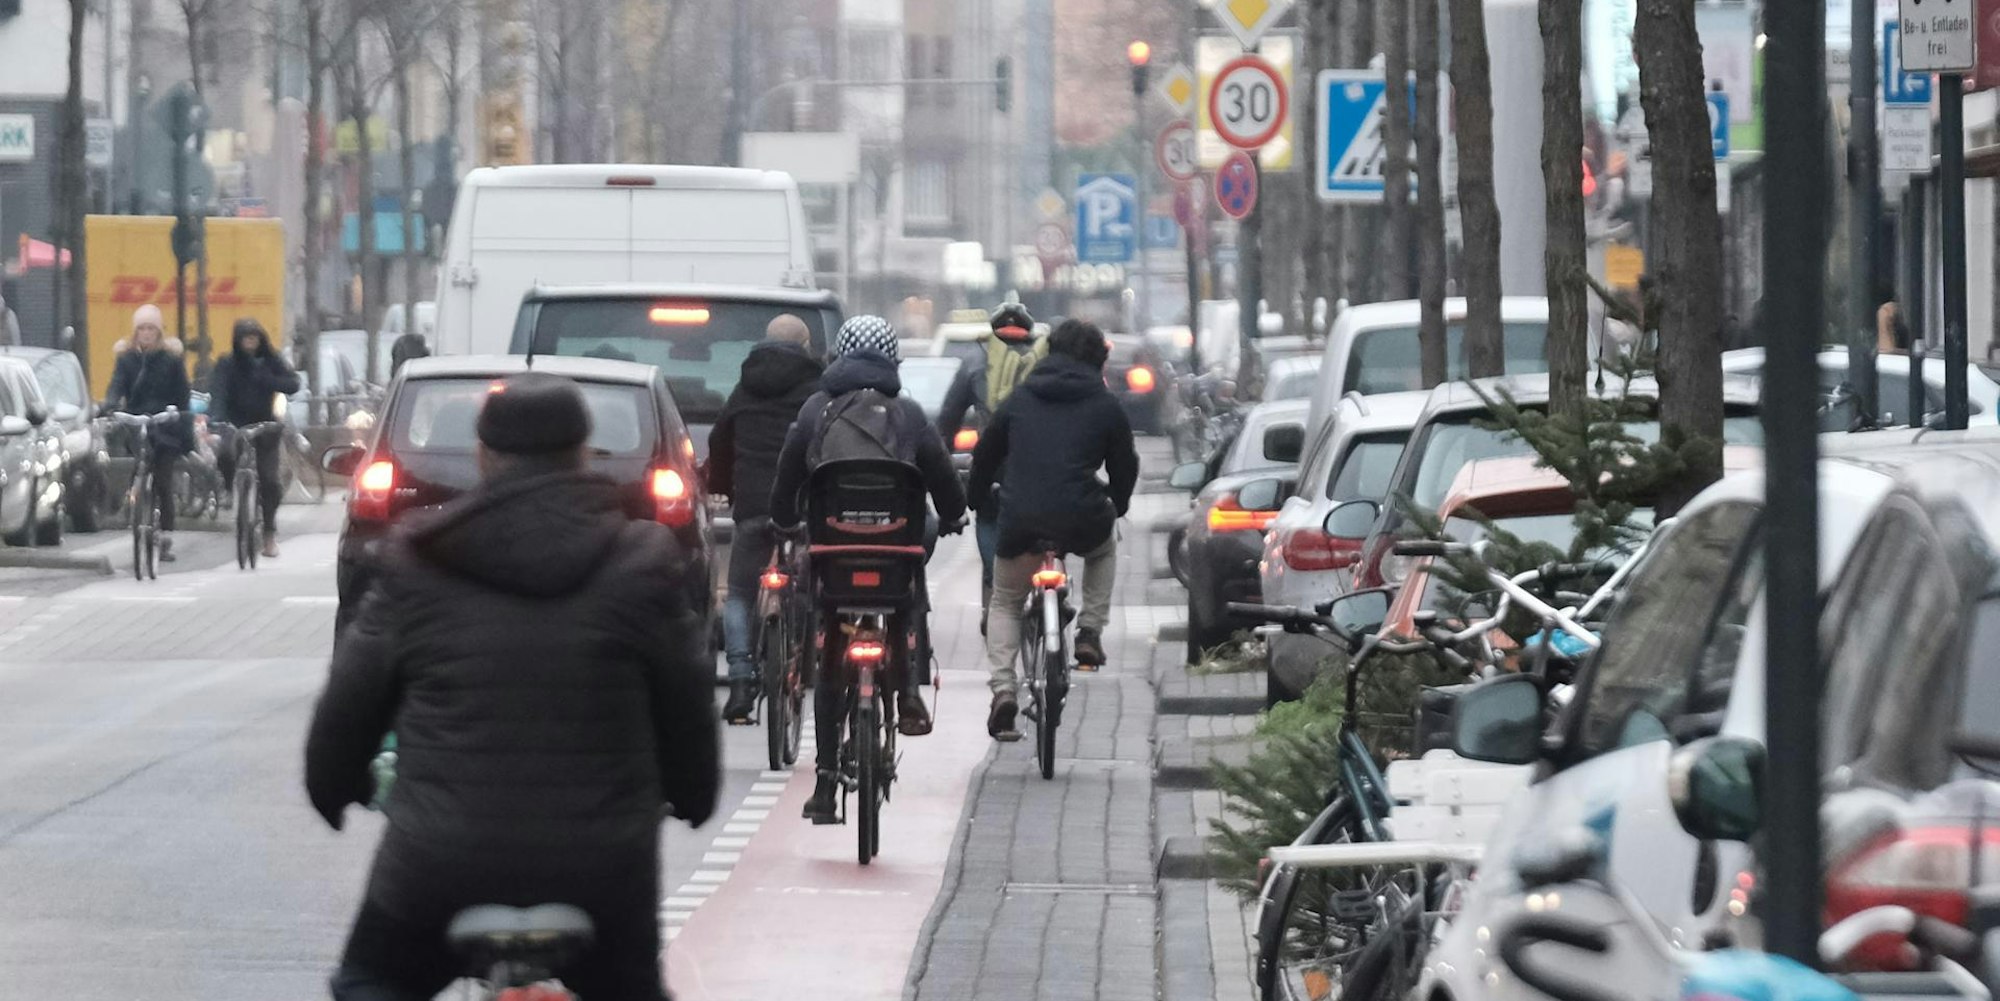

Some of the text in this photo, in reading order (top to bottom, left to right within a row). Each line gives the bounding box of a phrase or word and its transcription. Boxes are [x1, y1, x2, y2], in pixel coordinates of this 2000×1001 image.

[1904, 18, 1919, 34] Be-
[1932, 14, 1969, 32] Entladen
[1928, 39, 1948, 55] frei
[1225, 81, 1271, 123] 30
[1086, 192, 1122, 236] P
[110, 275, 243, 305] DHL
